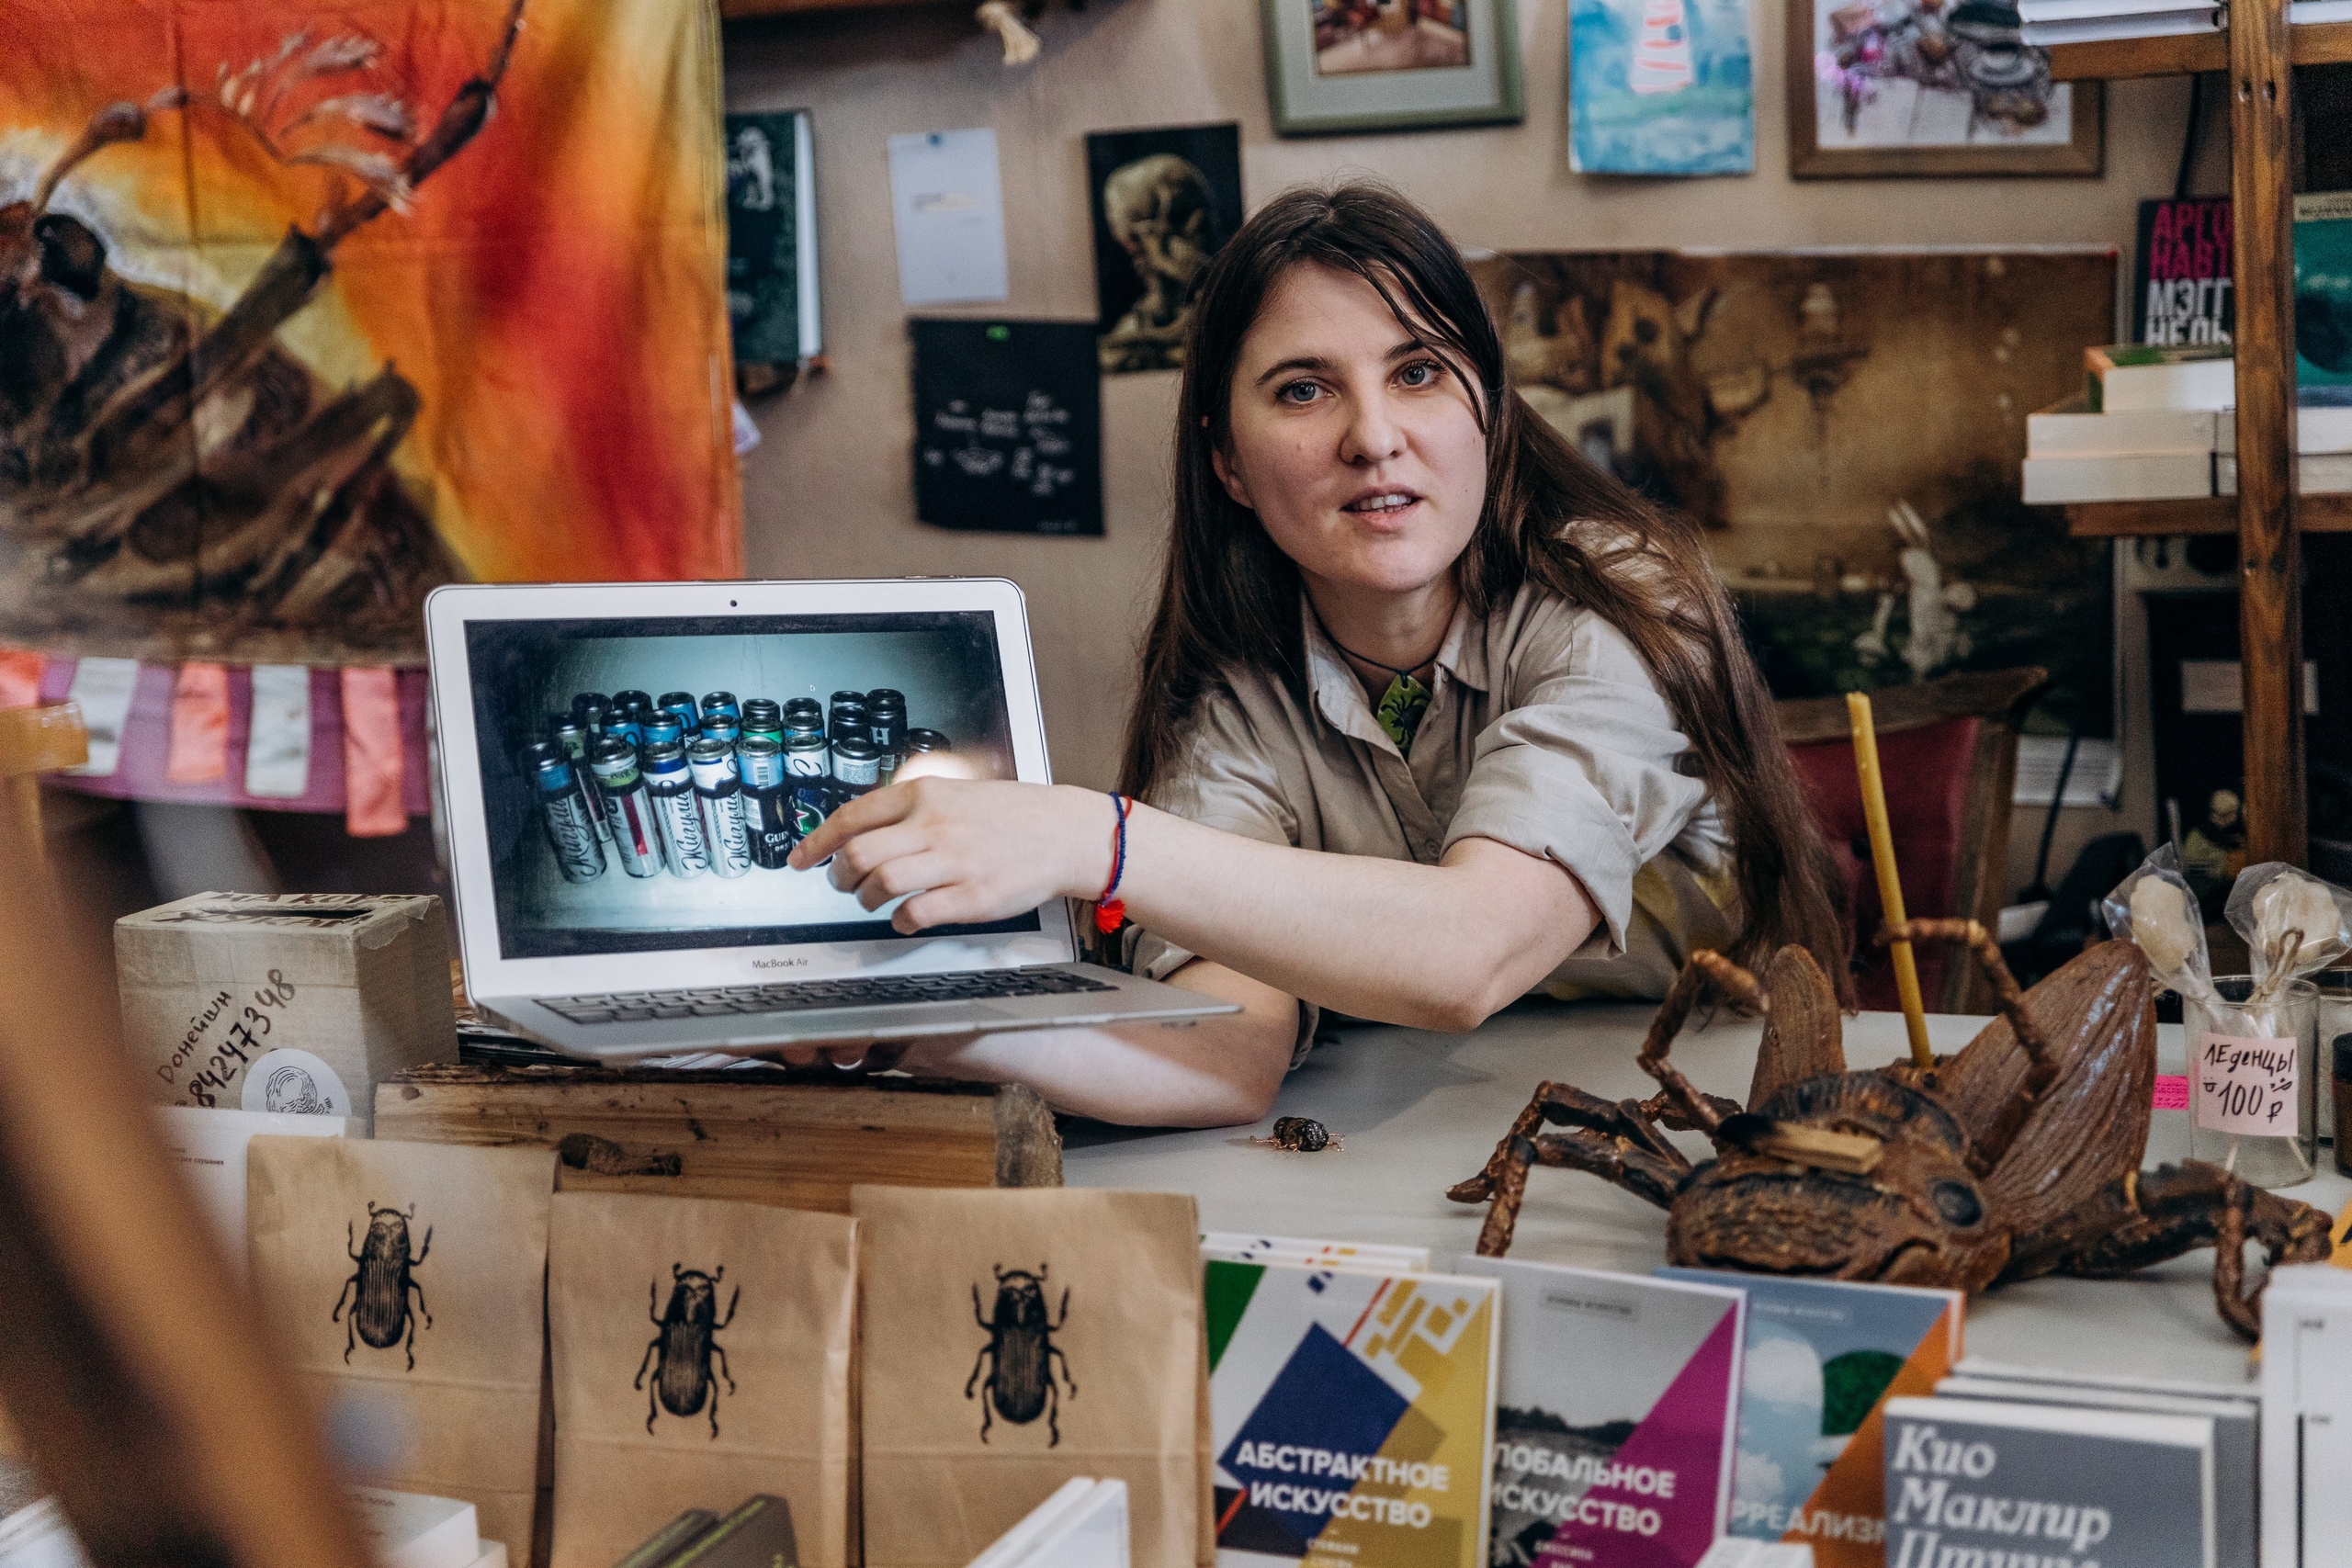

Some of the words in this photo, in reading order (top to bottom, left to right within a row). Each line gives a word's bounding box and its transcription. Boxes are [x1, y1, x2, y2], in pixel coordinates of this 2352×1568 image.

[752, 958, 795, 969] MacBook
[797, 957, 808, 966] Air
[175, 968, 296, 1108] 84247348
[2217, 1079, 2265, 1117] 100
[1235, 1439, 1451, 1493] АБСТРАКТНОЕ
[1893, 1424, 1997, 1480] Кио
[1249, 1480, 1432, 1529] ИСКУССТВО
[1894, 1475, 2112, 1553] Маклир
